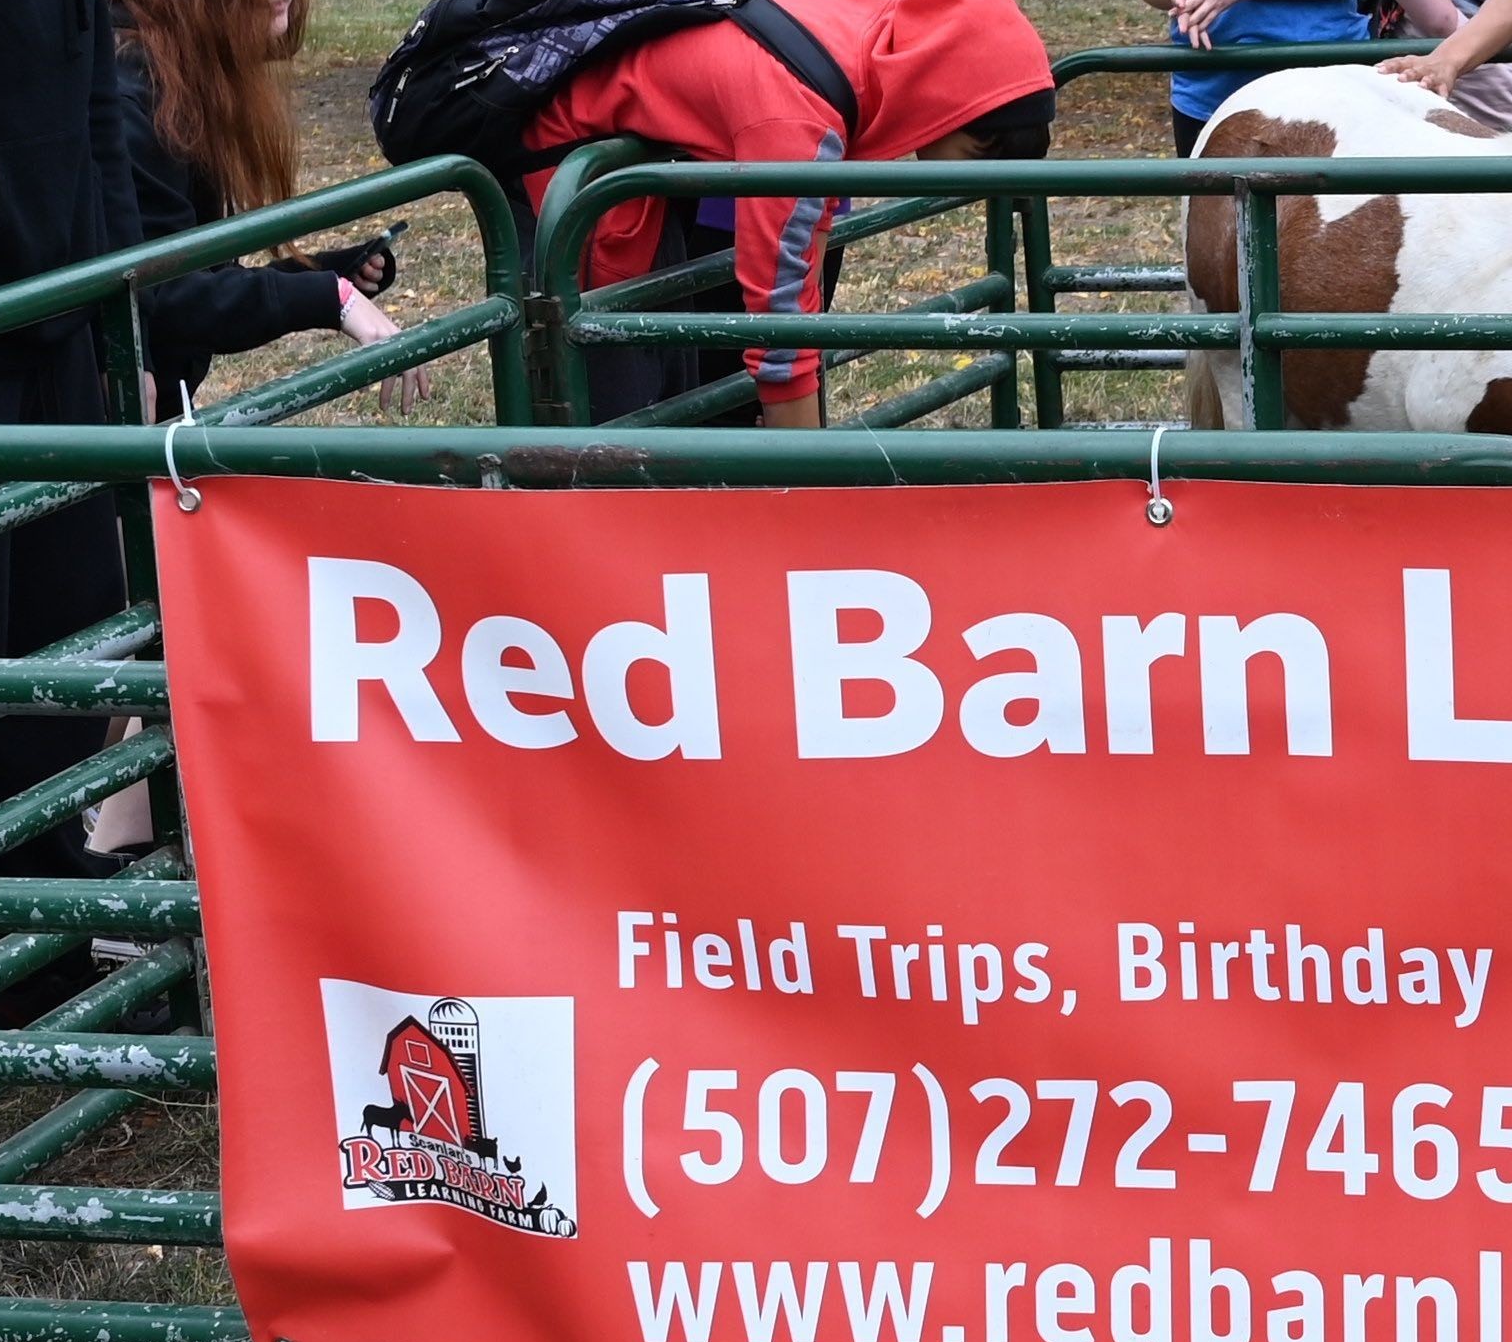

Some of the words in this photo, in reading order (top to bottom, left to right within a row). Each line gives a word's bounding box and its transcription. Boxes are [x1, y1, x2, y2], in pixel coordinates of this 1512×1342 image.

[308, 556, 723, 761] Red
[786, 569, 1333, 760] Barn
[618, 910, 814, 994] Field
[837, 924, 1078, 1026] Trips,
[1117, 922, 1494, 1028] Birthday
[344, 1138, 436, 1186] RED
[439, 1154, 526, 1210] BARN
[408, 1134, 474, 1165] Scanlan's
[405, 1183, 485, 1212] LEARNING
[490, 1205, 534, 1229] FARM
